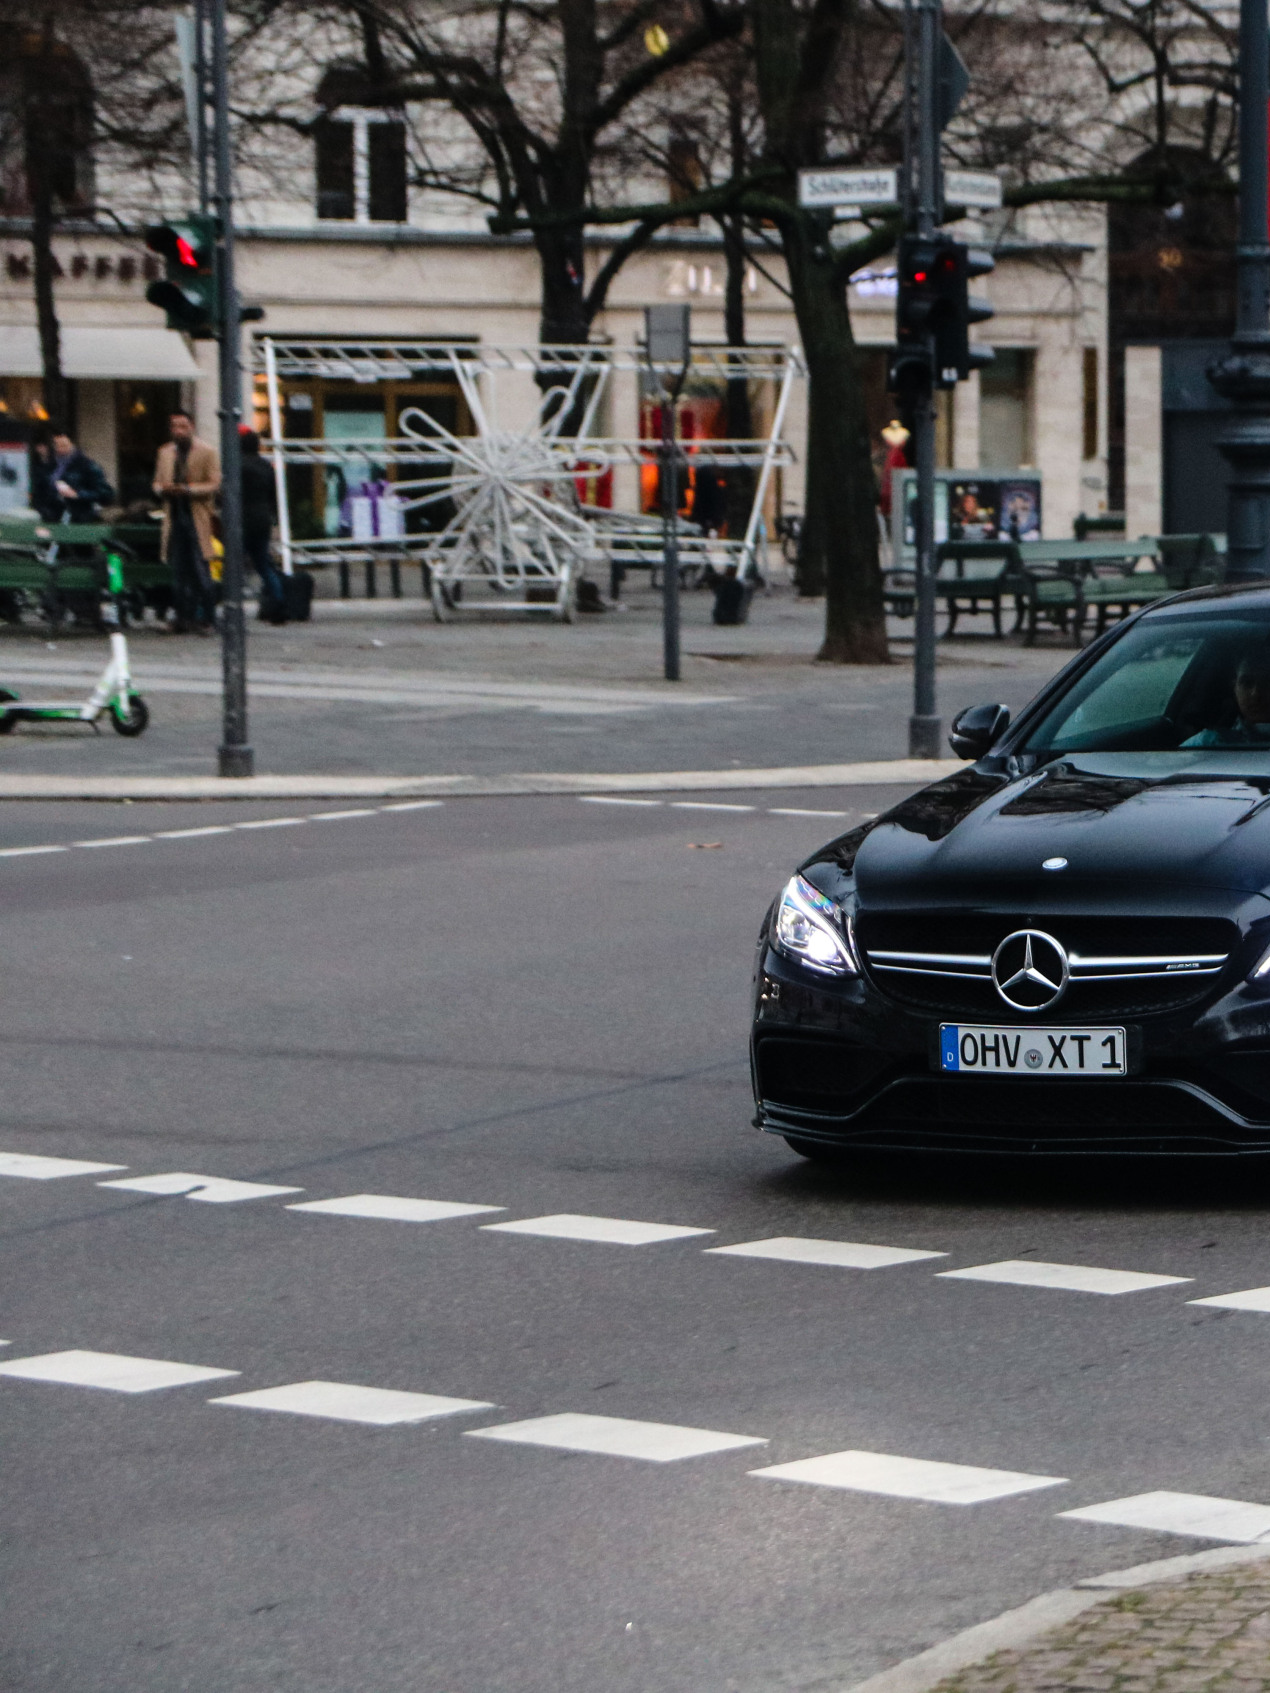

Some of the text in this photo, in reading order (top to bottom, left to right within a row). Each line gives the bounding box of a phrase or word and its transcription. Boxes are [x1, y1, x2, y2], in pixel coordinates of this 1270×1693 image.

[947, 1051, 954, 1061] D
[960, 1032, 1122, 1069] OHV XT 1
